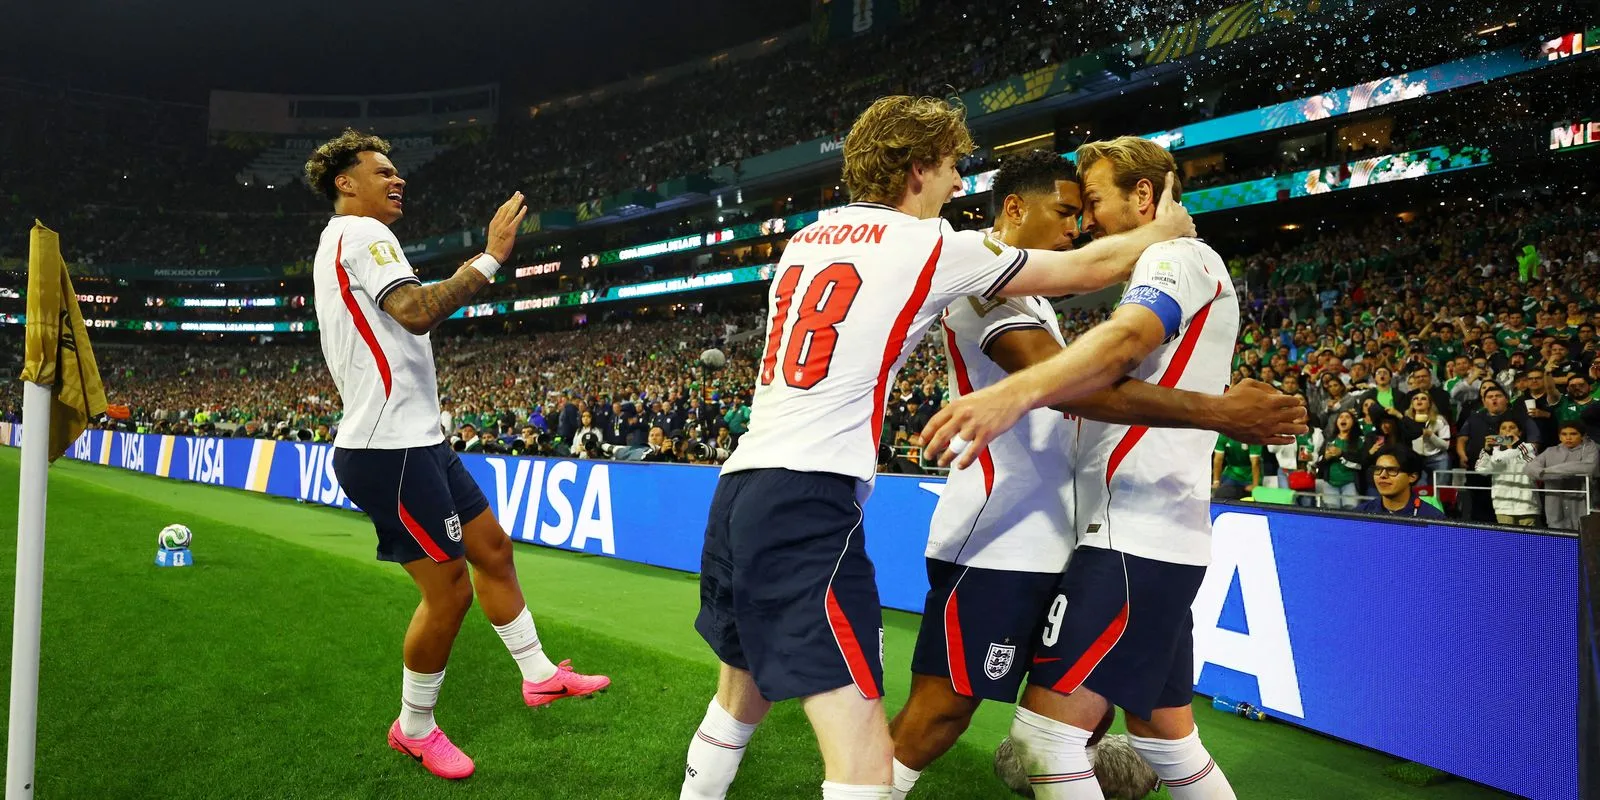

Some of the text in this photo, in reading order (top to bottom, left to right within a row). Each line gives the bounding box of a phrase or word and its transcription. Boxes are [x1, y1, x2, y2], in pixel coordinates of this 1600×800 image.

[761, 262, 863, 390] 18
[120, 433, 144, 471] VISA
[186, 437, 224, 485] VISA
[485, 457, 616, 555] VISA
[1042, 594, 1068, 647] 9
